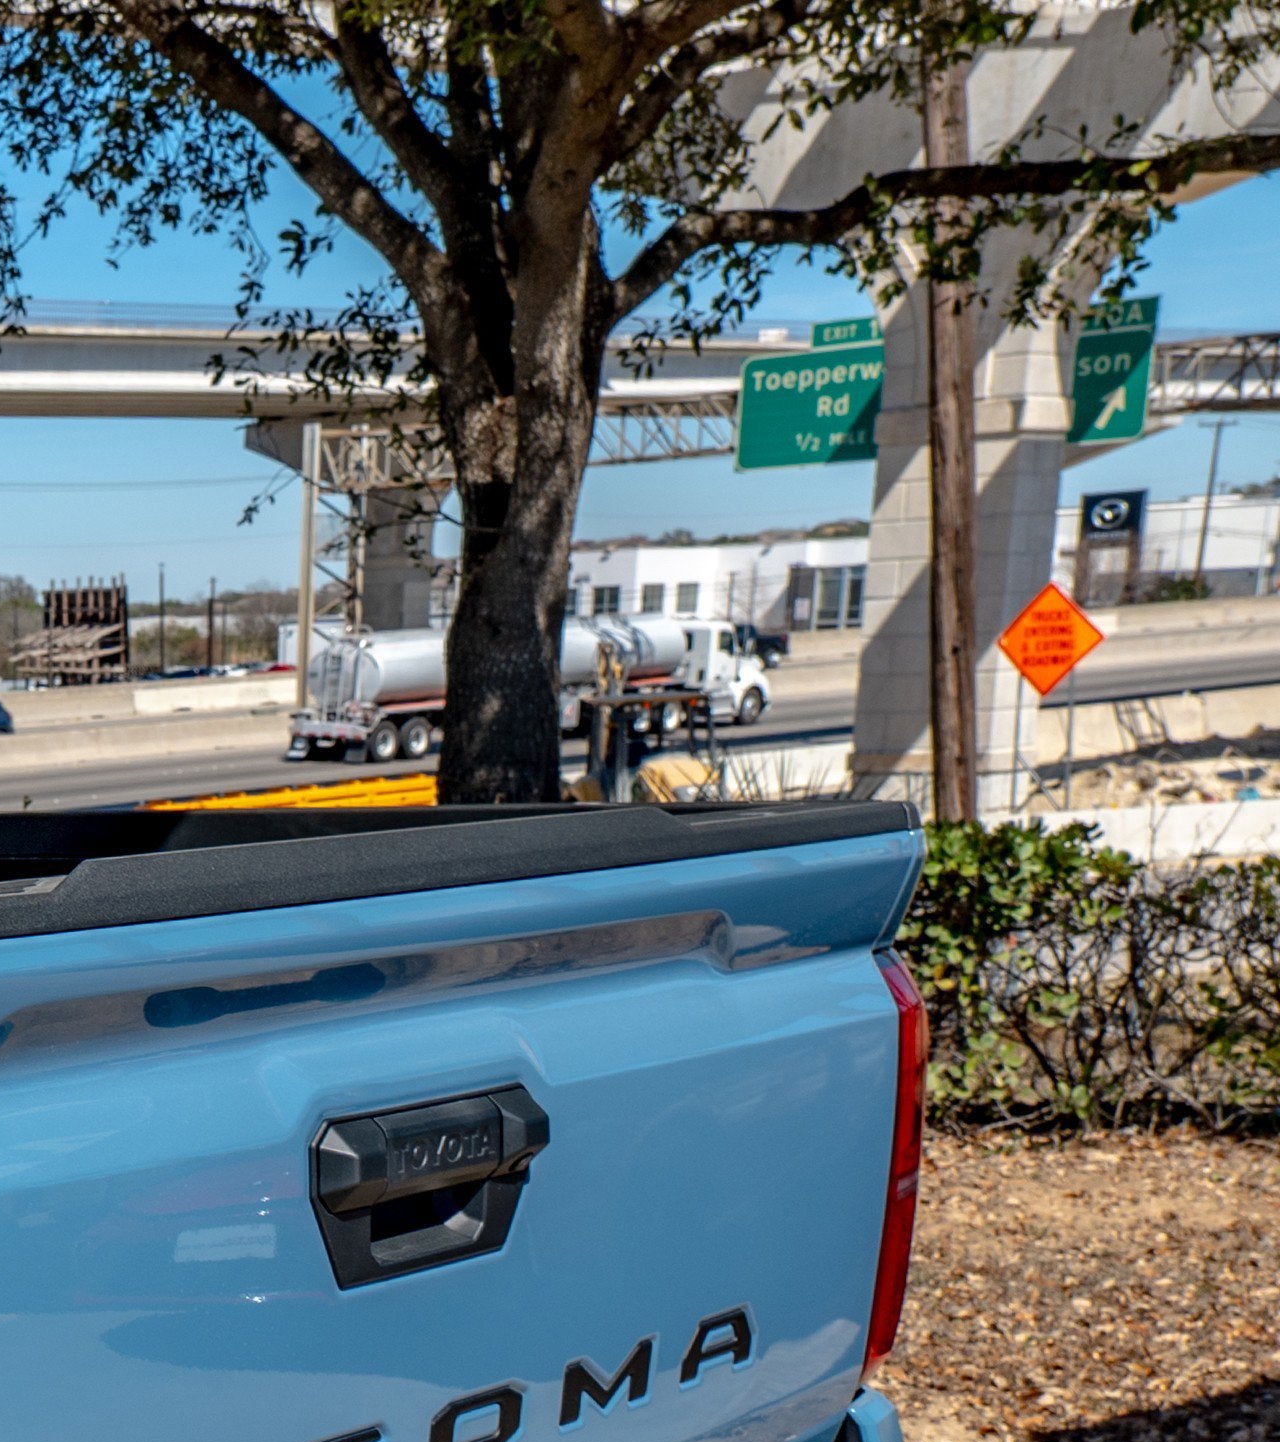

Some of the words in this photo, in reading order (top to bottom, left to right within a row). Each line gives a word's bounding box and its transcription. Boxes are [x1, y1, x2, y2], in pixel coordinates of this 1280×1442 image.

[823, 324, 857, 341] EXIT
[752, 361, 887, 393] Toepperw
[1077, 353, 1131, 376] son
[816, 393, 850, 418] Rd
[392, 1128, 496, 1174] TOYOTA
